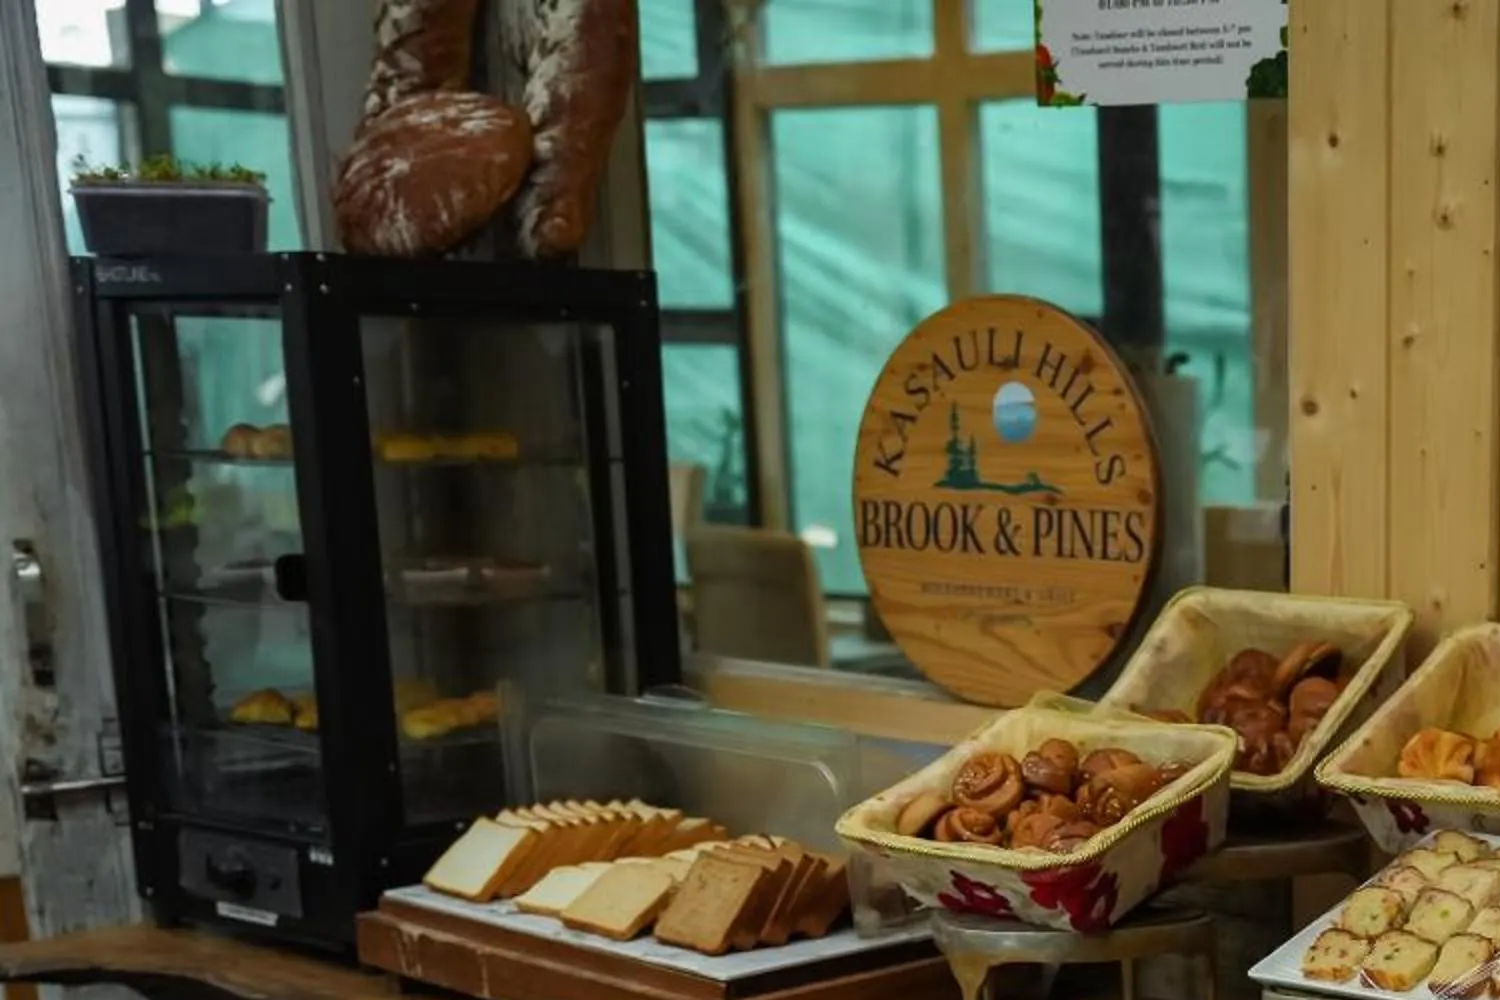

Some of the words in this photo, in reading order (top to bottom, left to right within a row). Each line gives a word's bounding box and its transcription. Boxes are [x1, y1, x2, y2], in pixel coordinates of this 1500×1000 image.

[873, 326, 1026, 479] KASAULI
[1035, 342, 1127, 487] HILLS
[860, 499, 985, 555] BROOK
[993, 507, 1023, 558] &
[1031, 506, 1146, 564] PINES
